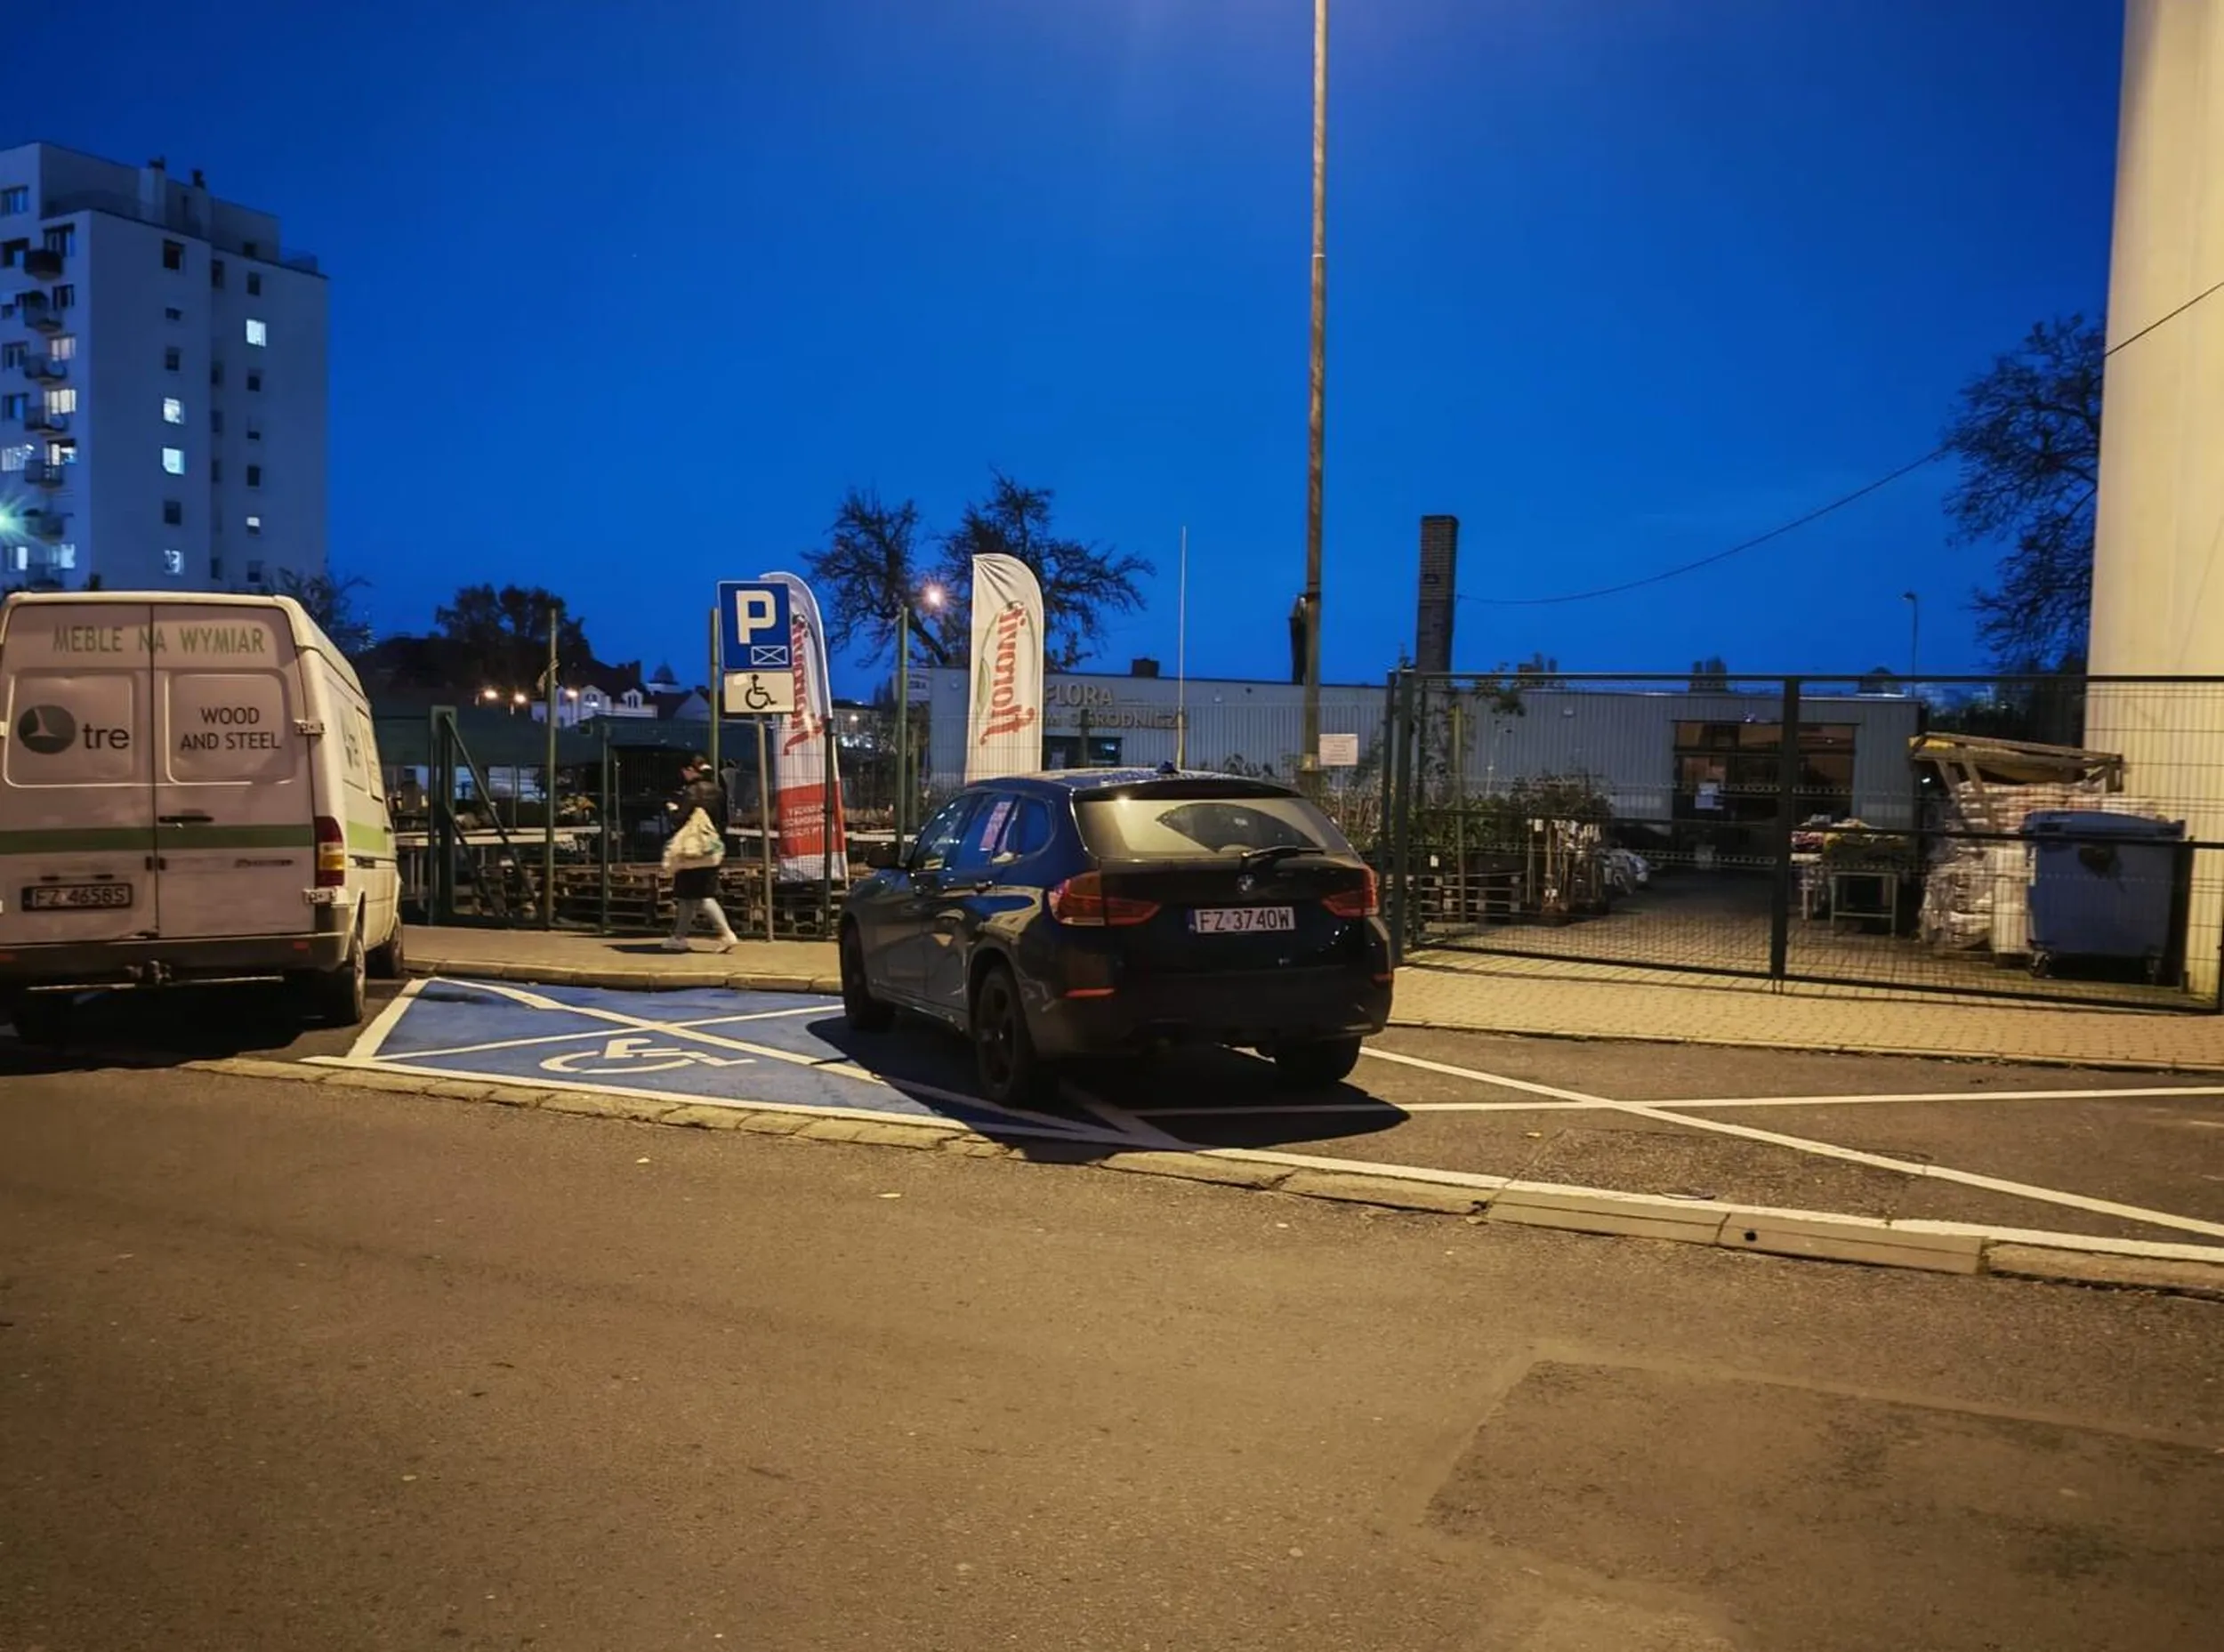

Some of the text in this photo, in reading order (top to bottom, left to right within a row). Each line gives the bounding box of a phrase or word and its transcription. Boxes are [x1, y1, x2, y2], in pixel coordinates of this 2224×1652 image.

[736, 591, 776, 644] P
[52, 626, 265, 654] MEBLE NA WYMIAR
[1045, 682, 1113, 706] FLORA
[200, 707, 260, 725] WOOD
[82, 722, 130, 750] tre
[180, 732, 282, 751] AND STEEL
[36, 890, 60, 907] FZ
[1199, 909, 1290, 931] FZ 3740W
